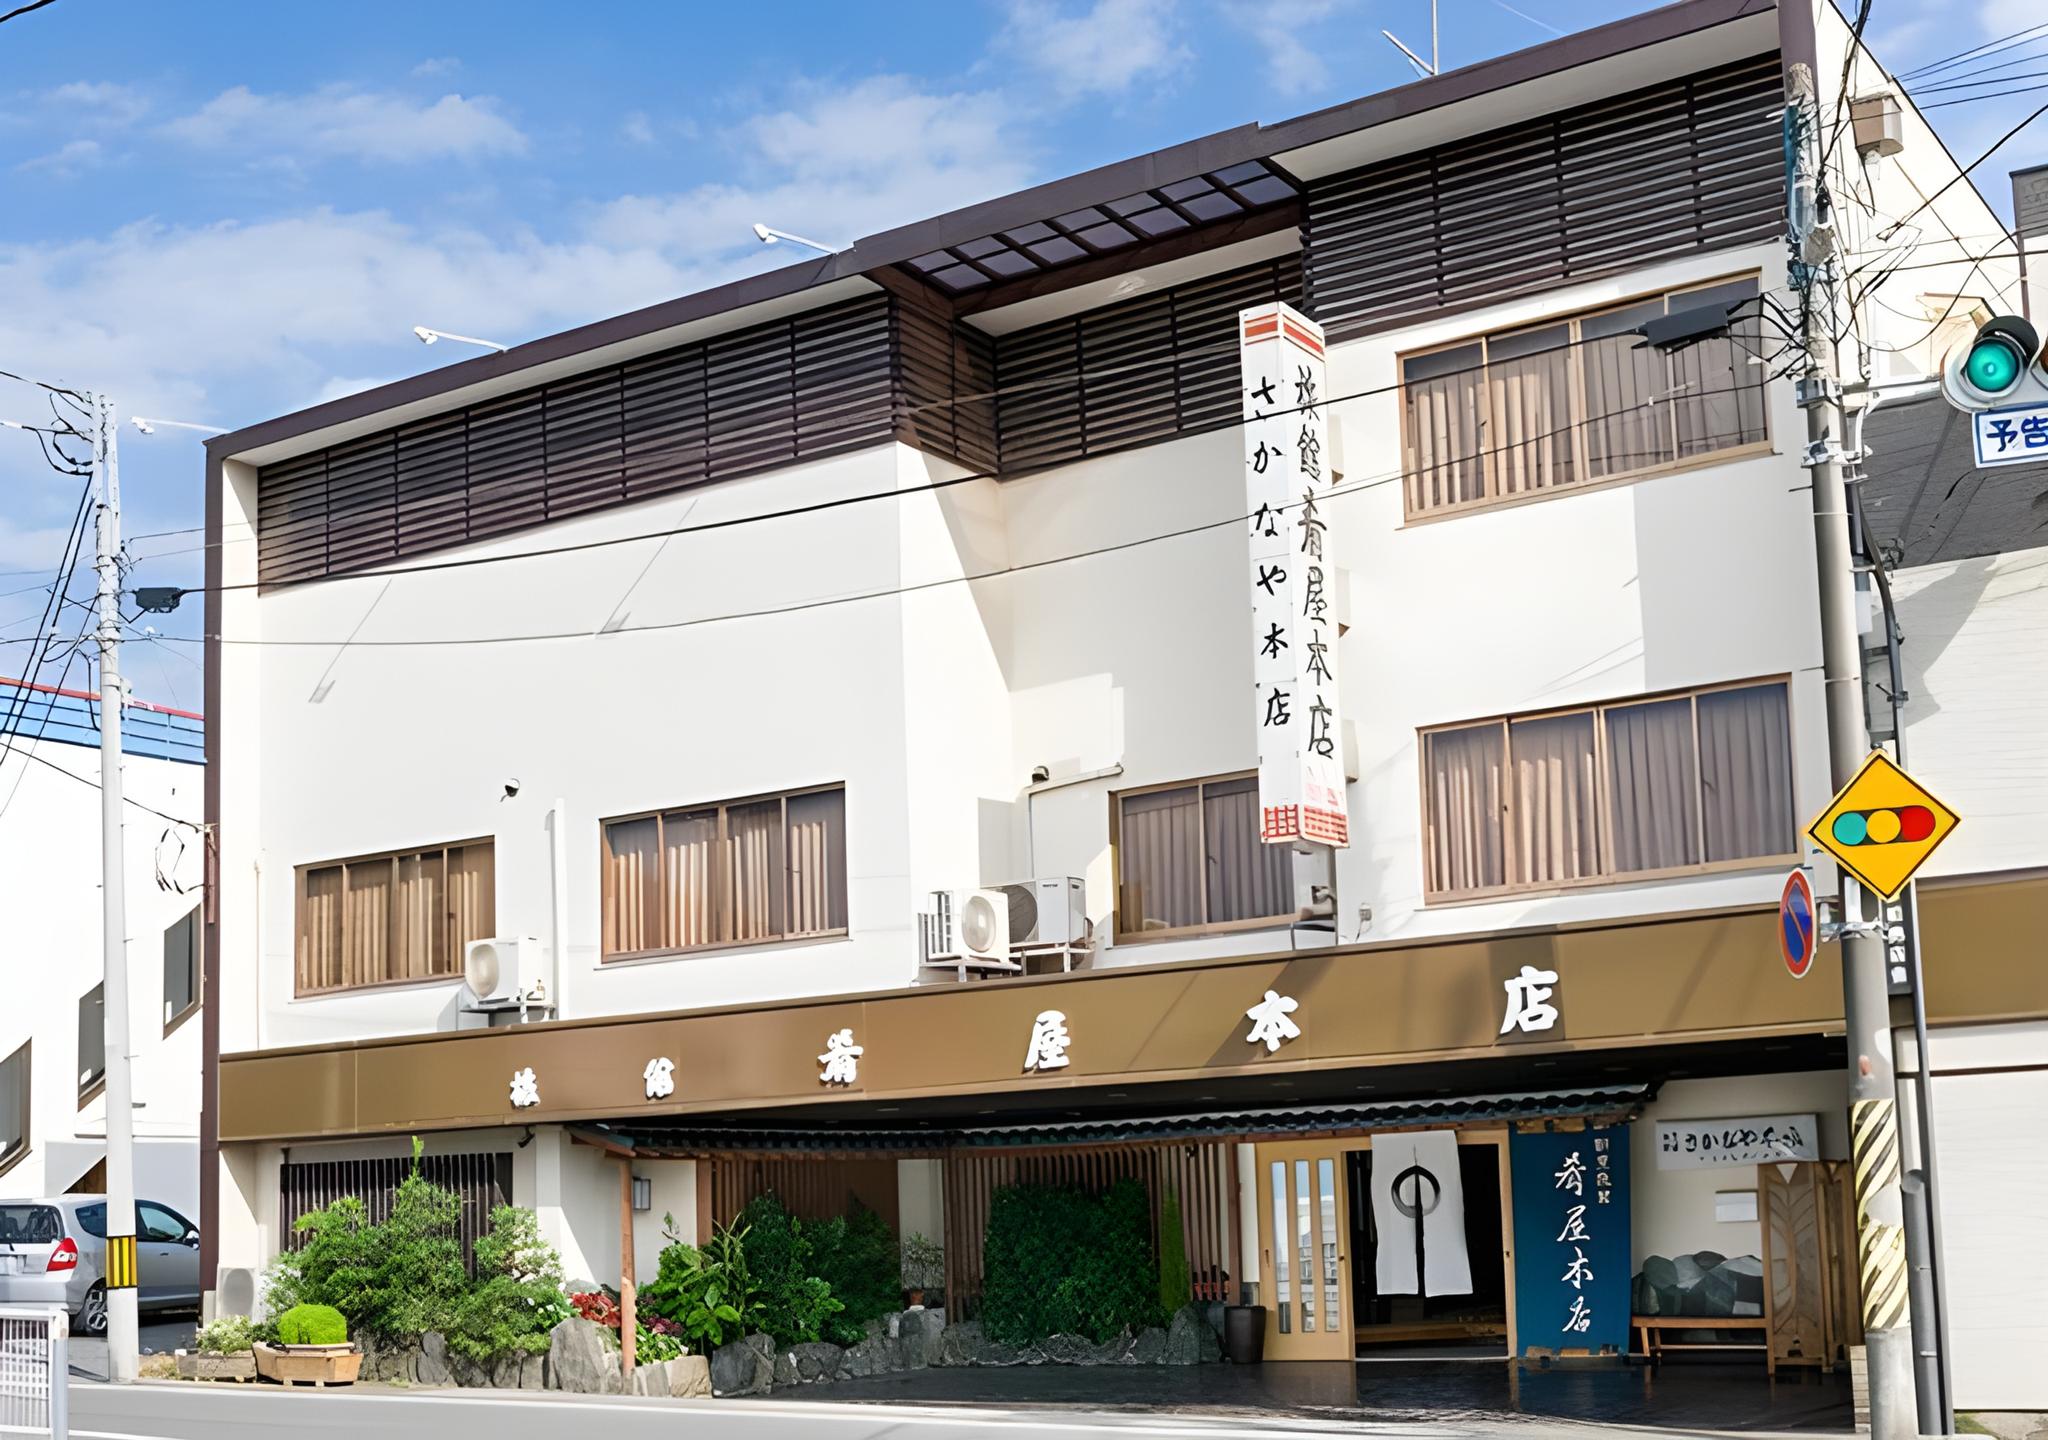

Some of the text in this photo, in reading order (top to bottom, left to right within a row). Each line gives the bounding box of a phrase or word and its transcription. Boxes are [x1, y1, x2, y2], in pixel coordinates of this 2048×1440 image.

[1986, 415, 2048, 452] 予告
[1250, 375, 1291, 728] さかなや本店
